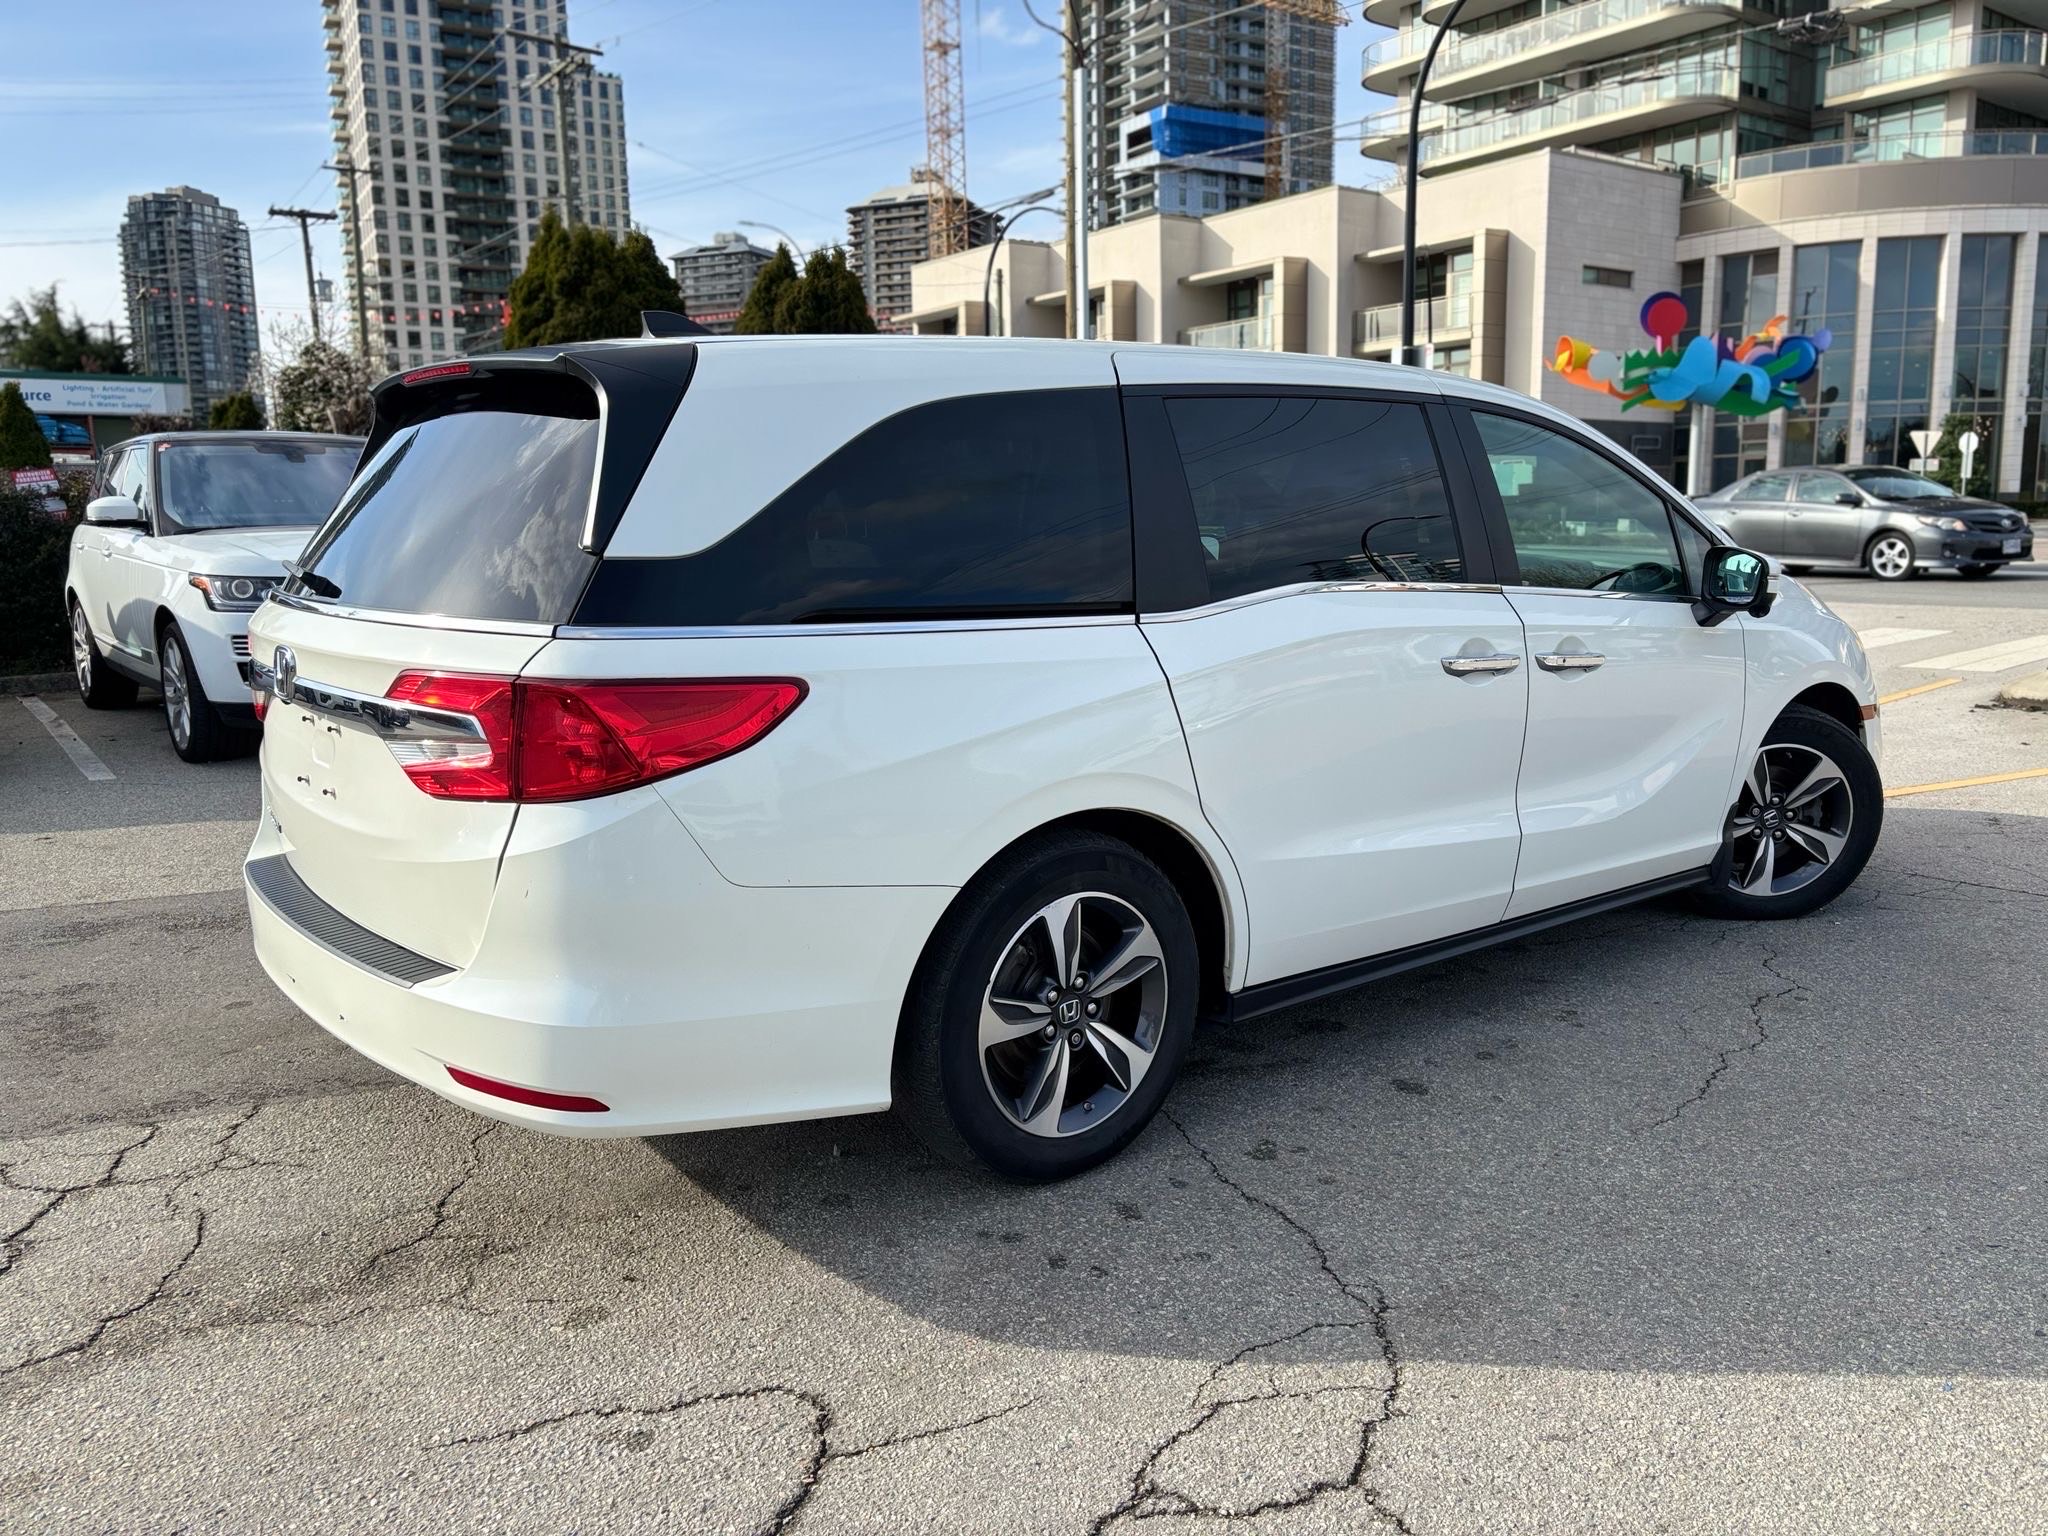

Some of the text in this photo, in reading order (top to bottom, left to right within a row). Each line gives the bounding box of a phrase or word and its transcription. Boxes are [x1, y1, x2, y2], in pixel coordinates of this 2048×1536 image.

[62, 384, 95, 393] Lighting
[102, 385, 135, 393] Artificial
[137, 386, 153, 394] Turf
[20, 391, 52, 401] urce
[91, 393, 127, 401] Irrigation
